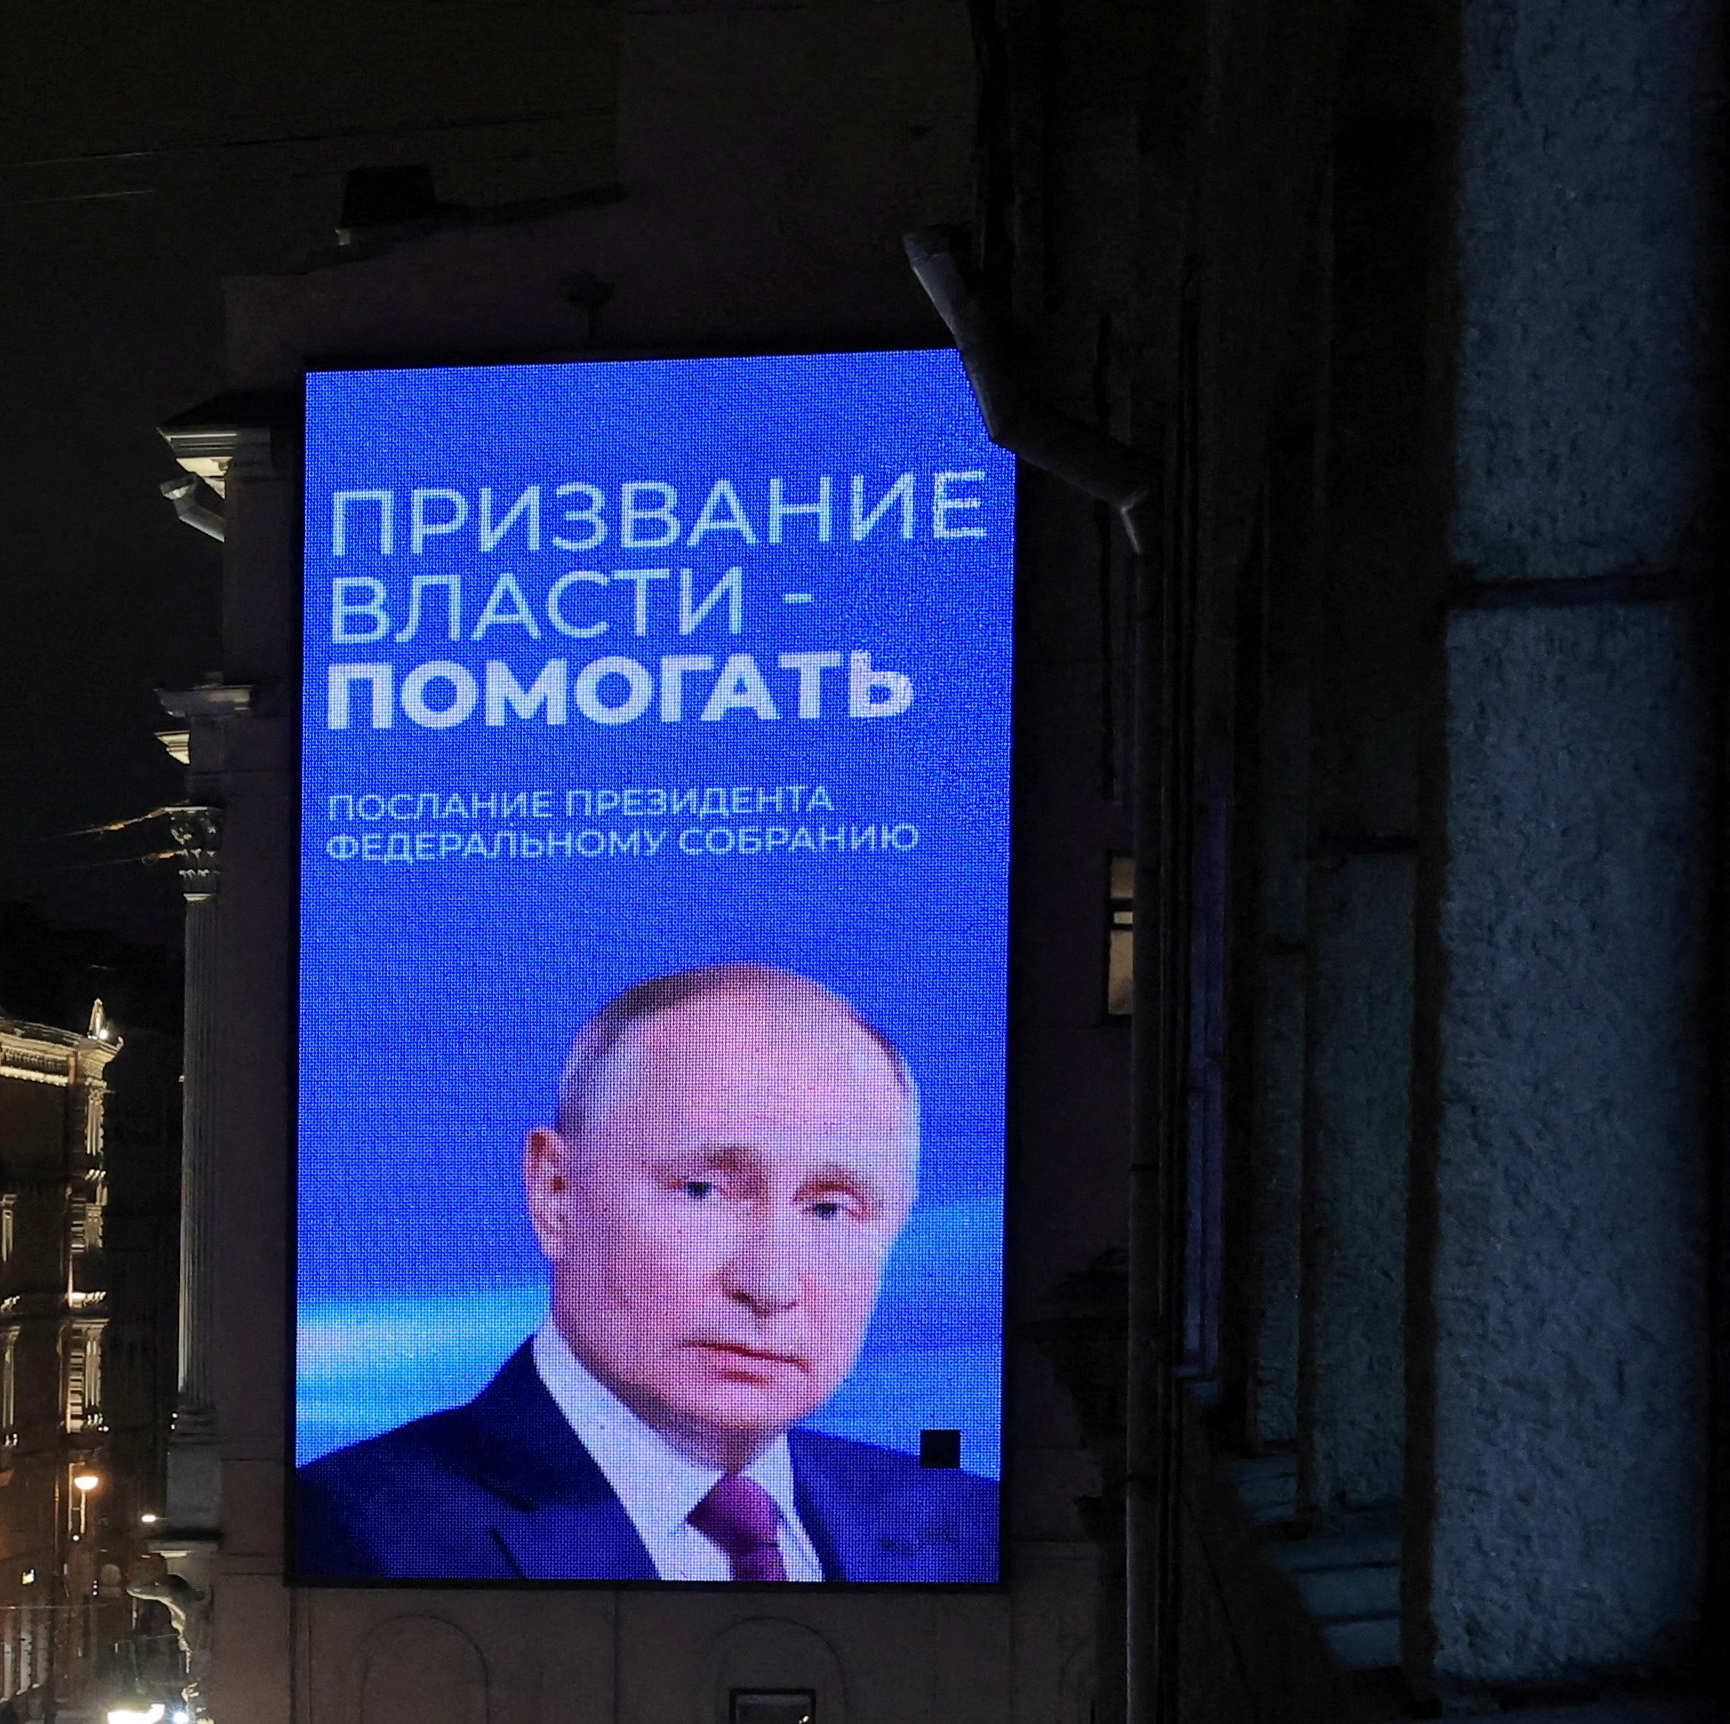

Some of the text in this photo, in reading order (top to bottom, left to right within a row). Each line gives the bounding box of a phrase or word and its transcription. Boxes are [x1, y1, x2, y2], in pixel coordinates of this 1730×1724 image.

[331, 471, 987, 556] ПРИЗВАНИЕ
[331, 566, 743, 645] ВЛАСТИ
[326, 650, 915, 729] ПОМОГАТЬ
[328, 784, 834, 823] ПОСЛАНИЕ ПРЕЗИДЕНТА
[326, 823, 920, 864] ФЕДЕРАЛЬНОМУ СОБРАНИЮ
